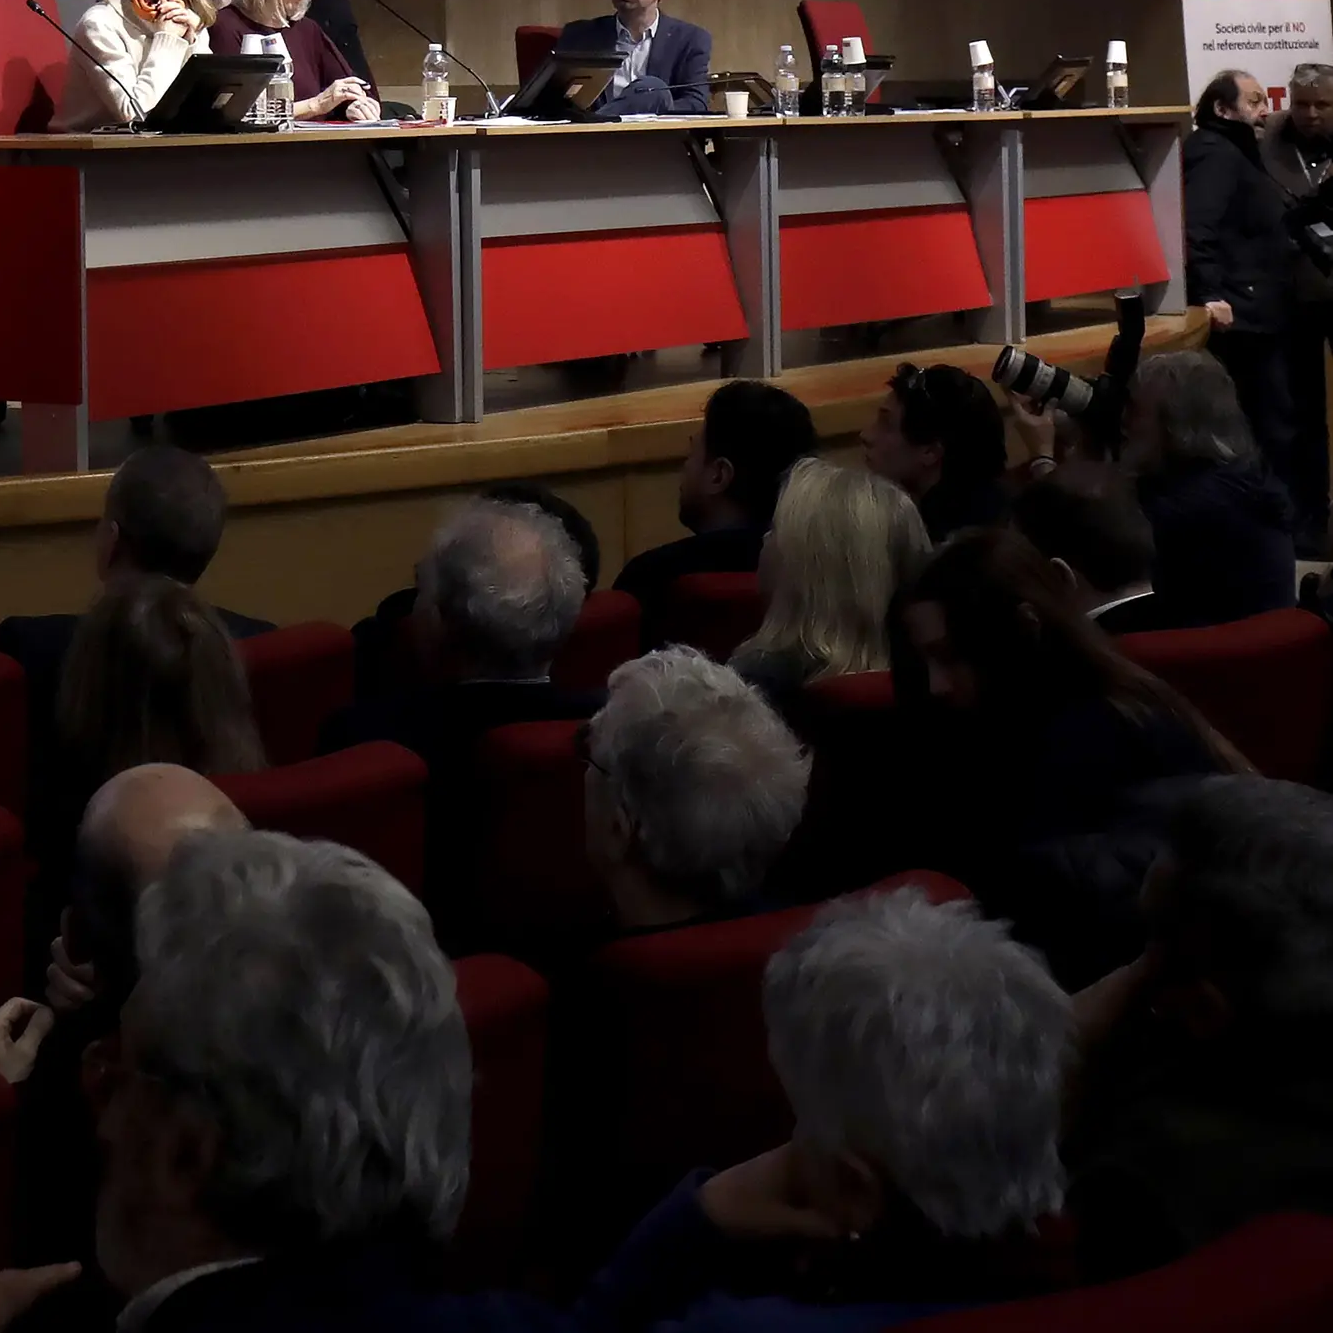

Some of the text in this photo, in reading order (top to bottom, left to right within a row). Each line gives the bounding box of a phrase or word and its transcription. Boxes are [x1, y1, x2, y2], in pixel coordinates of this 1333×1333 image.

[1268, 24, 1282, 36] per
[1202, 39, 1215, 51] nel
[1217, 39, 1262, 51] referendum
